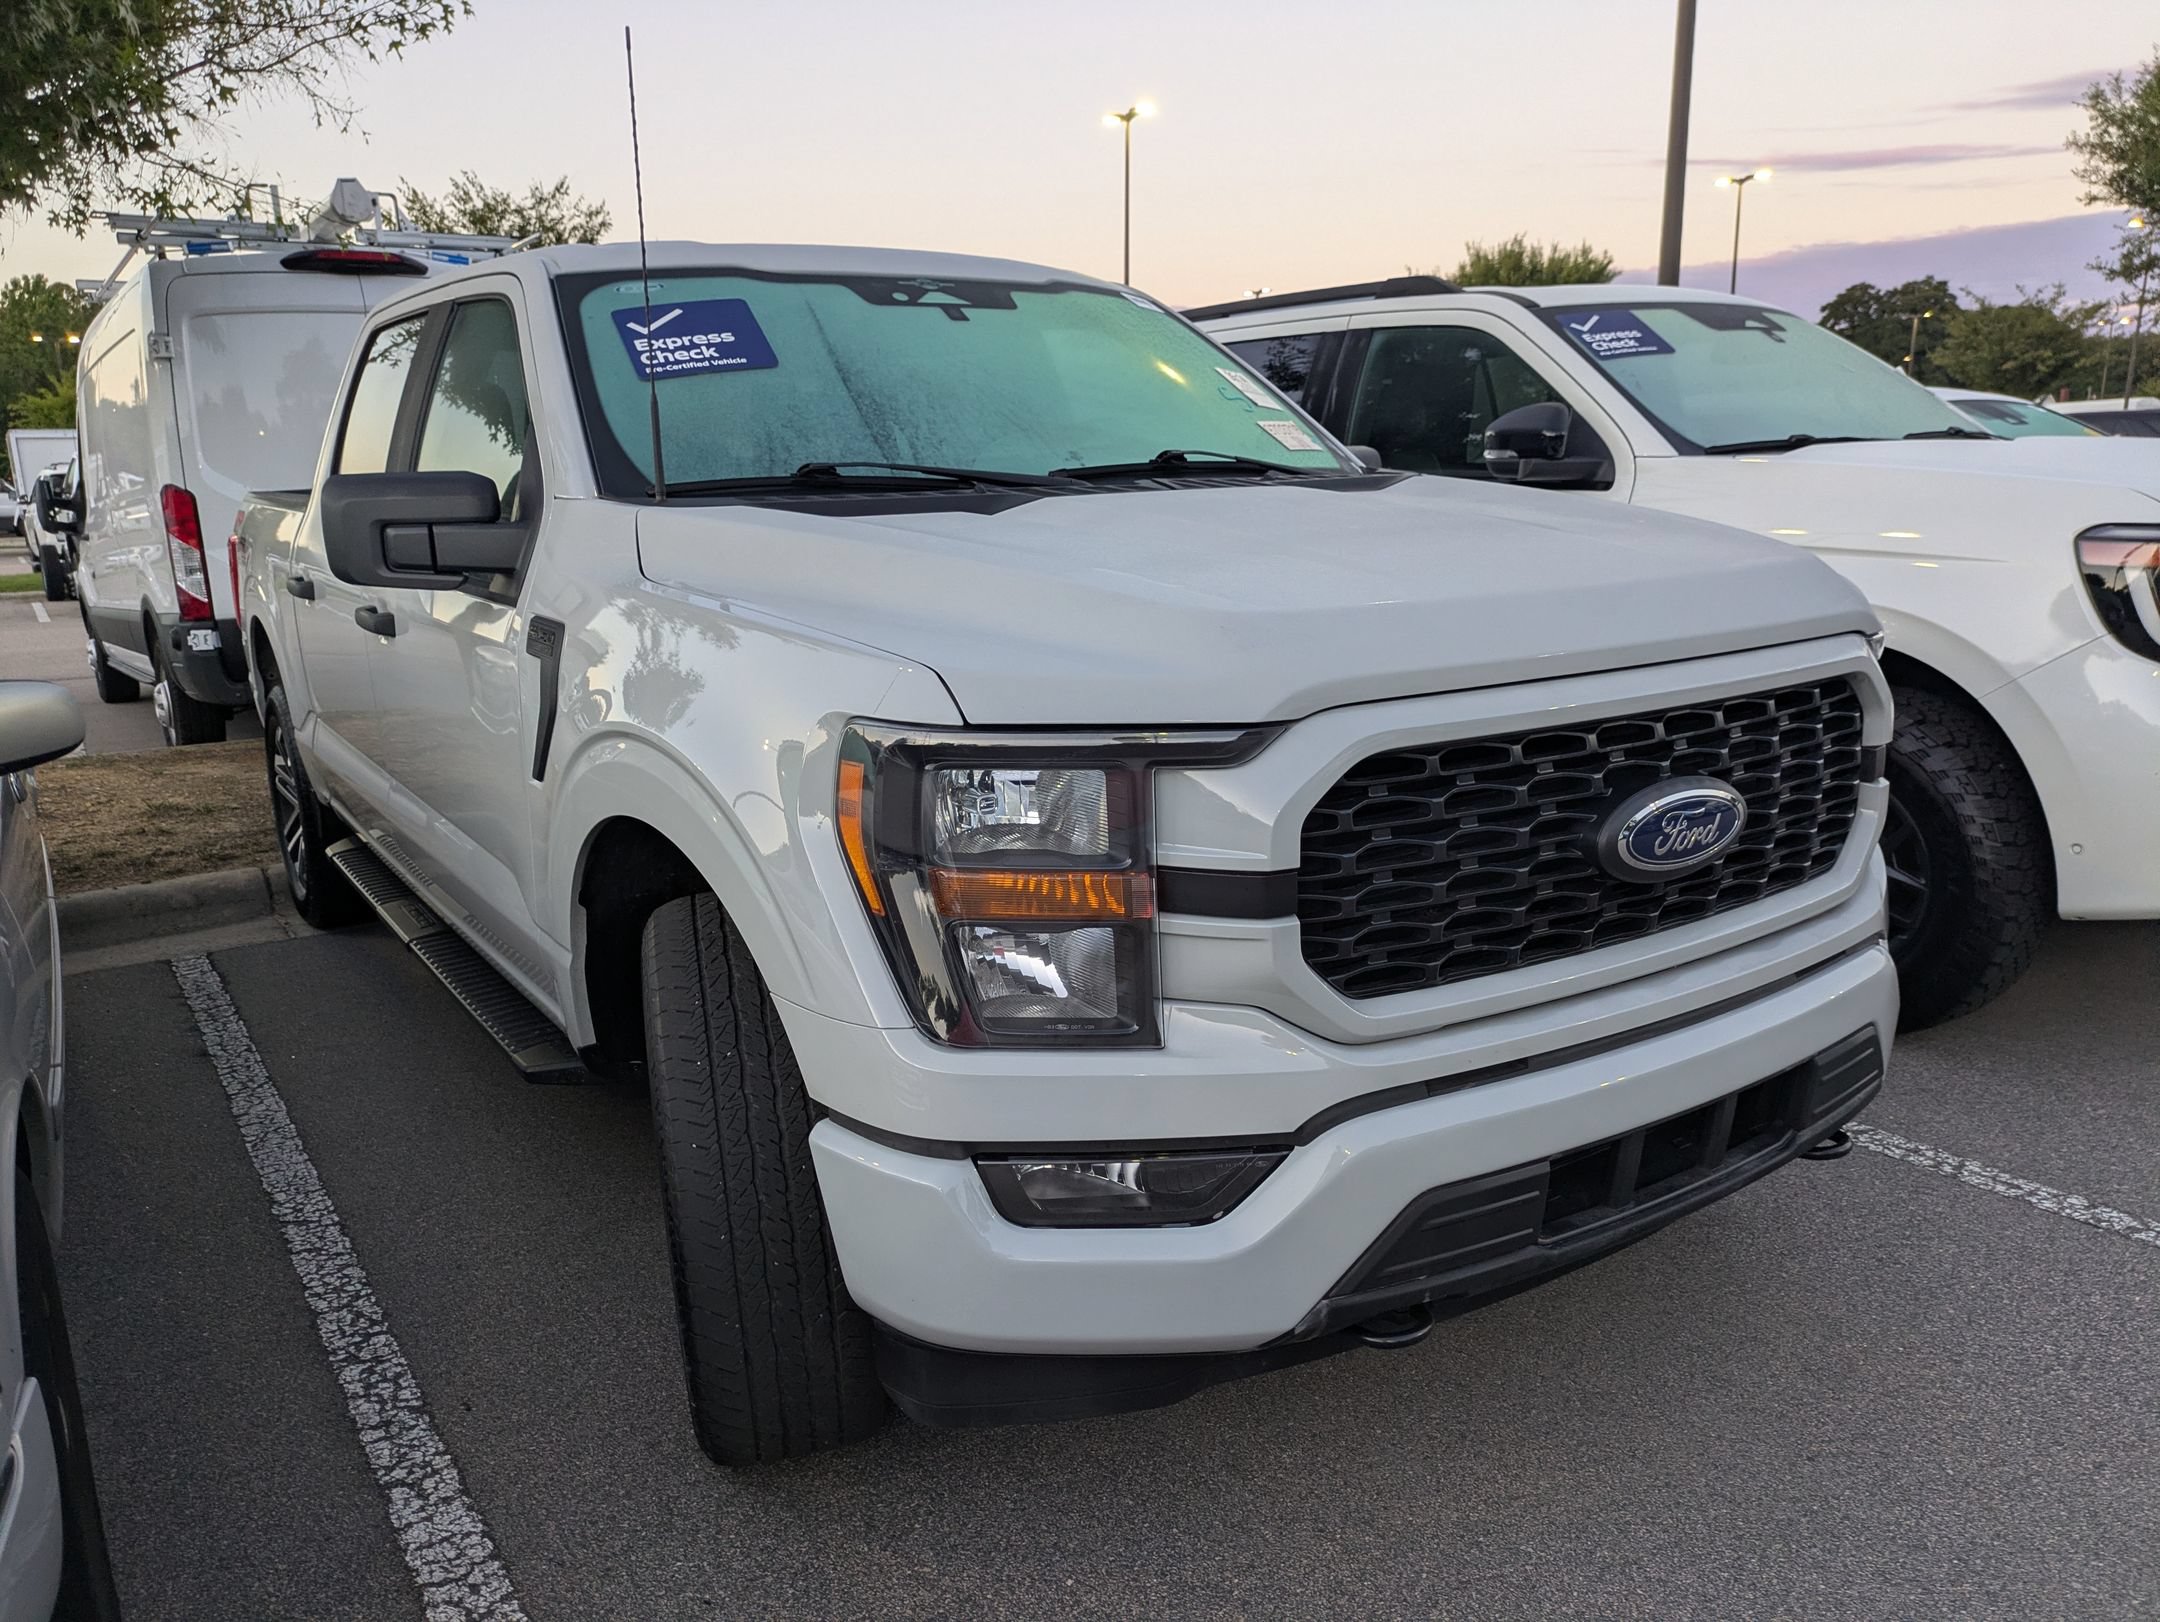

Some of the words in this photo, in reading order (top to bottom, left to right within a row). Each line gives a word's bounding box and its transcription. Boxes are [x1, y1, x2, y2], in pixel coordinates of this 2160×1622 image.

[633, 332, 736, 351] Express
[1581, 330, 1642, 342] Express
[1591, 338, 1640, 351] Check
[640, 345, 720, 365] Check
[645, 360, 710, 374] Pre-Certified
[711, 357, 748, 366] Vehicle
[1654, 807, 1722, 856] Ford
